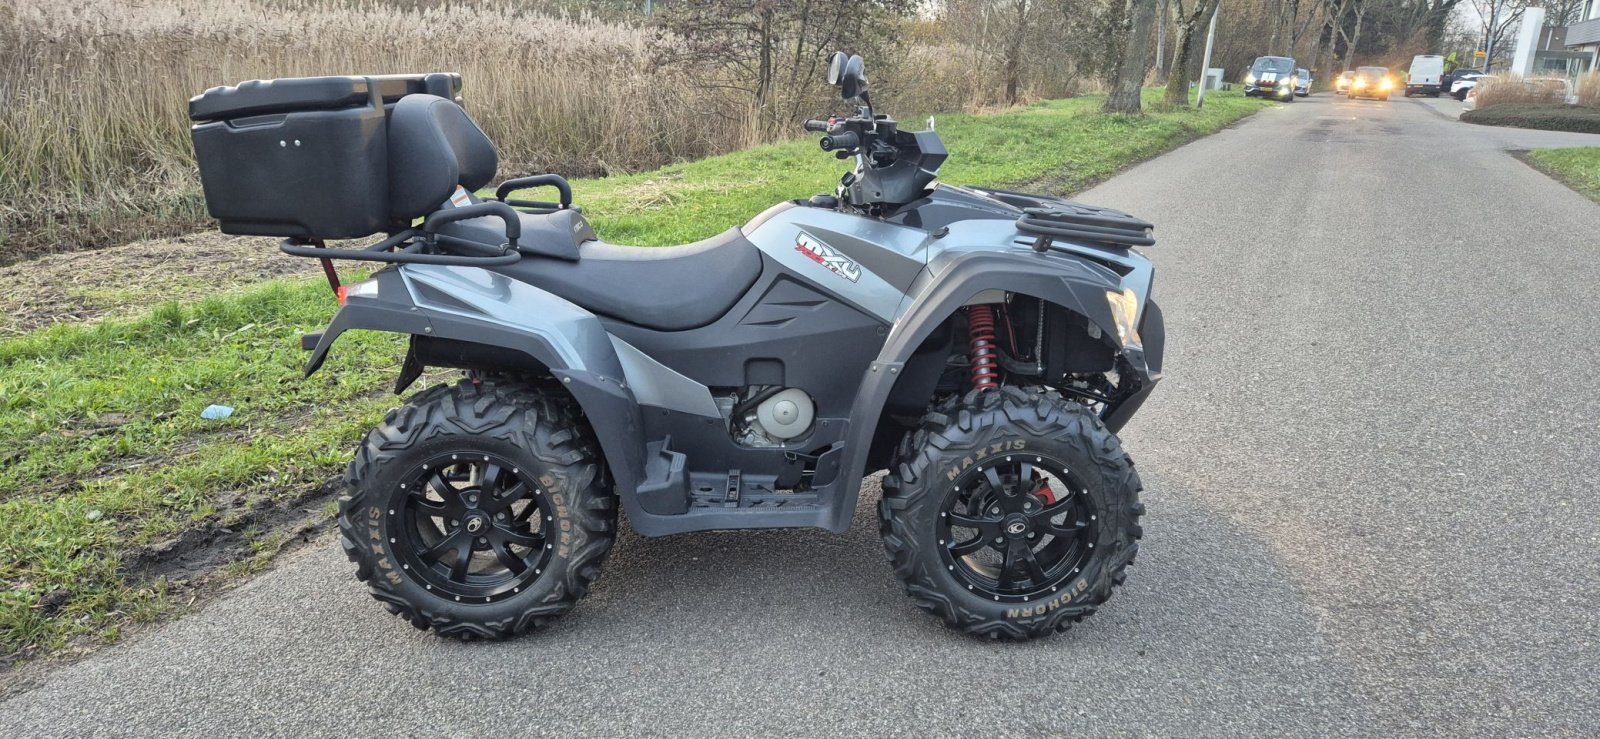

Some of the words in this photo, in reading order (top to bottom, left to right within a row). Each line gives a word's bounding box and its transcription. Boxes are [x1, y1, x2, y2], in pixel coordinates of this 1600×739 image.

[947, 439, 1026, 481] MAXXIS
[368, 506, 402, 586] MAXXIS
[539, 475, 571, 559] BIGHORN
[1007, 578, 1089, 619] BIGHORN
